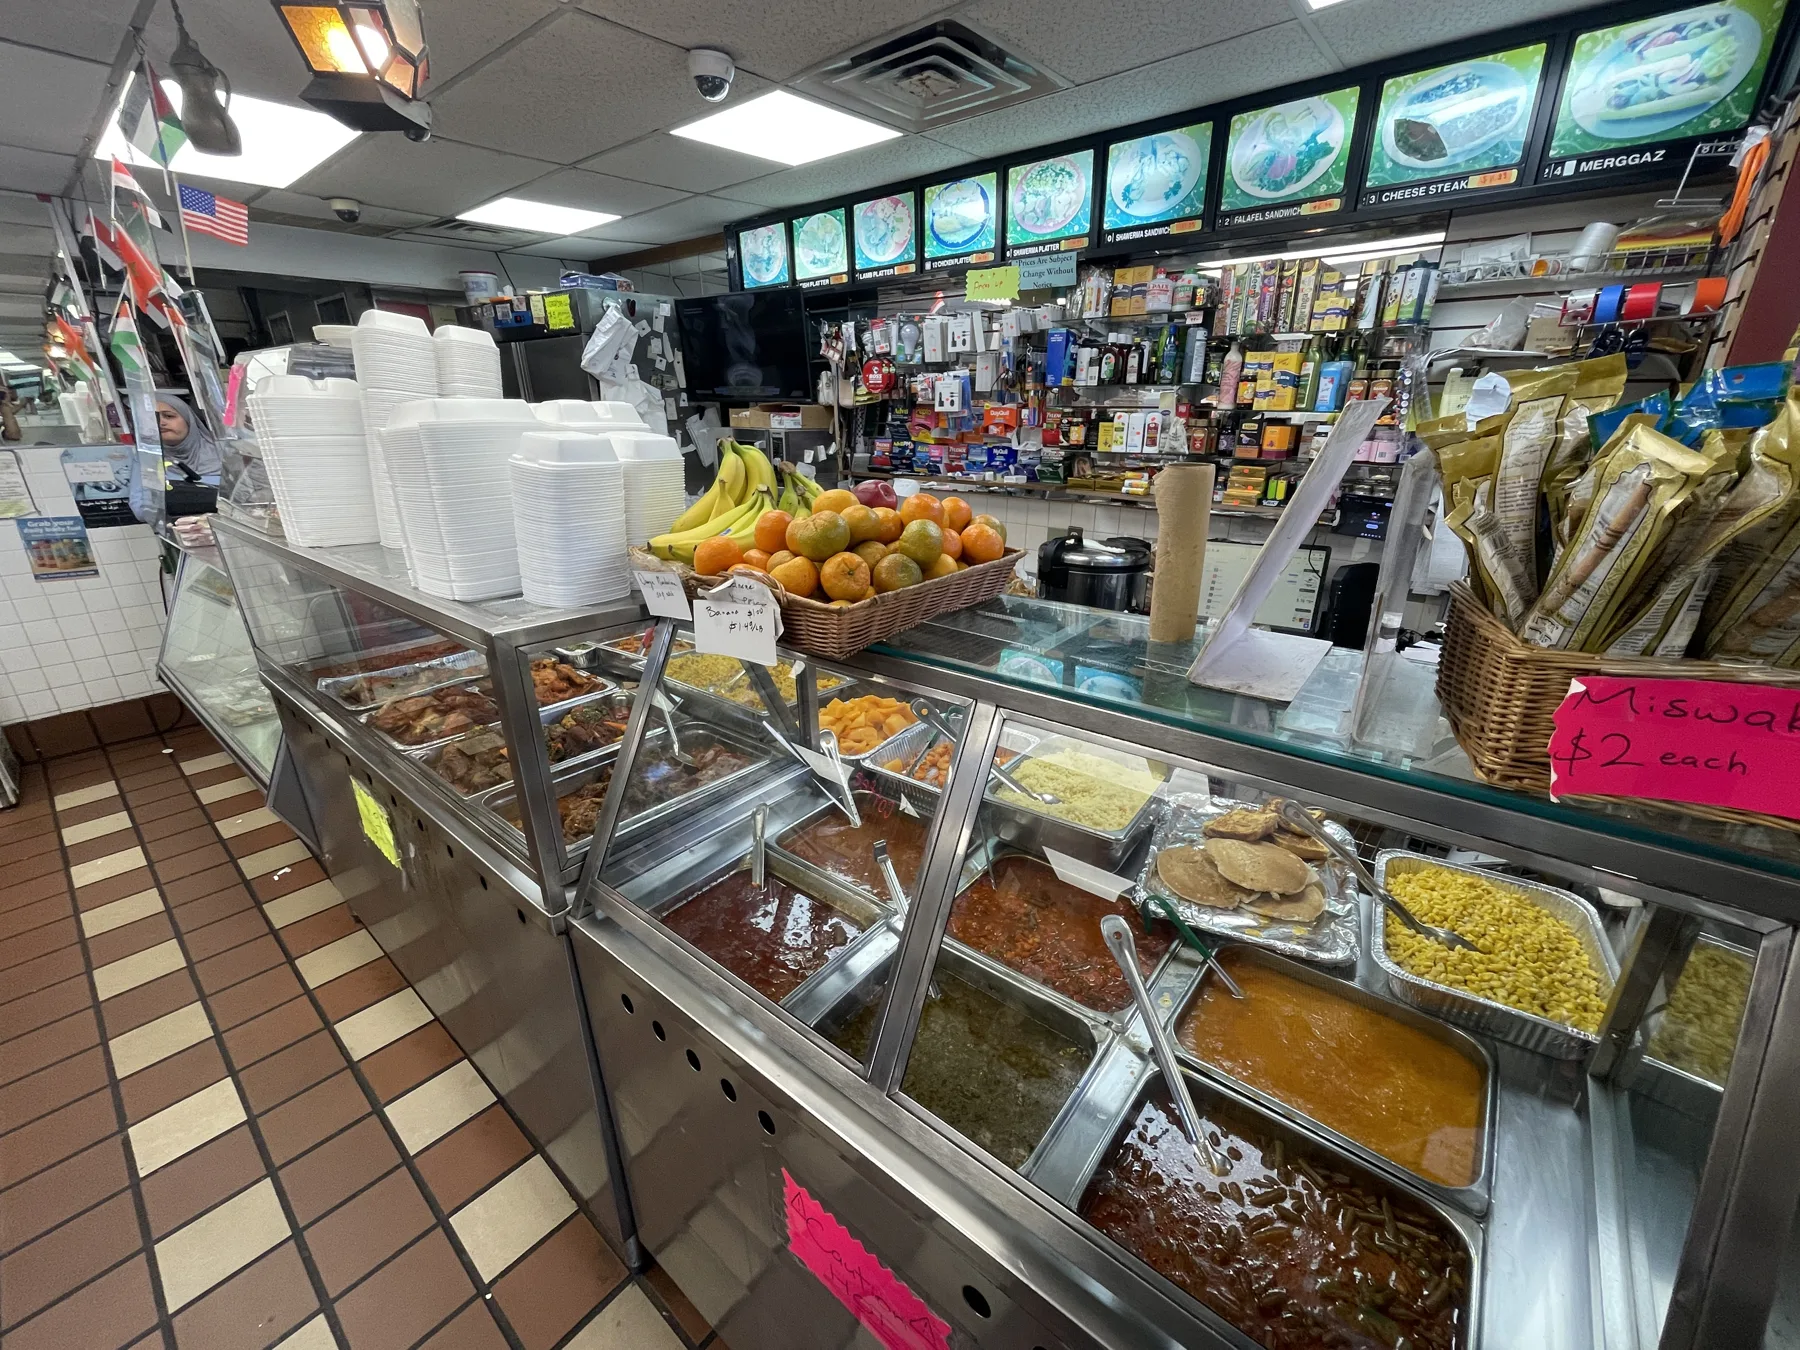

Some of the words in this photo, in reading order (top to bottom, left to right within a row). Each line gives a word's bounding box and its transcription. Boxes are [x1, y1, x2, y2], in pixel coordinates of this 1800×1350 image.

[1579, 149, 1666, 173] MERGGAZ
[1381, 187, 1426, 202] CHEESE
[1428, 179, 1468, 195] STEAK
[1234, 213, 1264, 224] FALAFEL
[1115, 230, 1143, 242] SHAWERMA
[1013, 246, 1038, 257] SHAWERMA
[1039, 242, 1060, 253] PLATTER
[1036, 256, 1048, 264] Are
[1048, 254, 1073, 266] Subject
[860, 271, 873, 280] LAMB
[873, 268, 894, 278] PLATTER
[1022, 269, 1045, 279] Change
[1046, 267, 1074, 276] Without
[810, 278, 829, 288] PLATTER
[1229, 301, 1241, 334] HERBAL
[990, 409, 1010, 417] DayQuil
[993, 448, 1008, 456] NyQuil
[705, 606, 739, 618] Banana
[1553, 727, 1645, 777] $2
[1659, 751, 1748, 776] each
